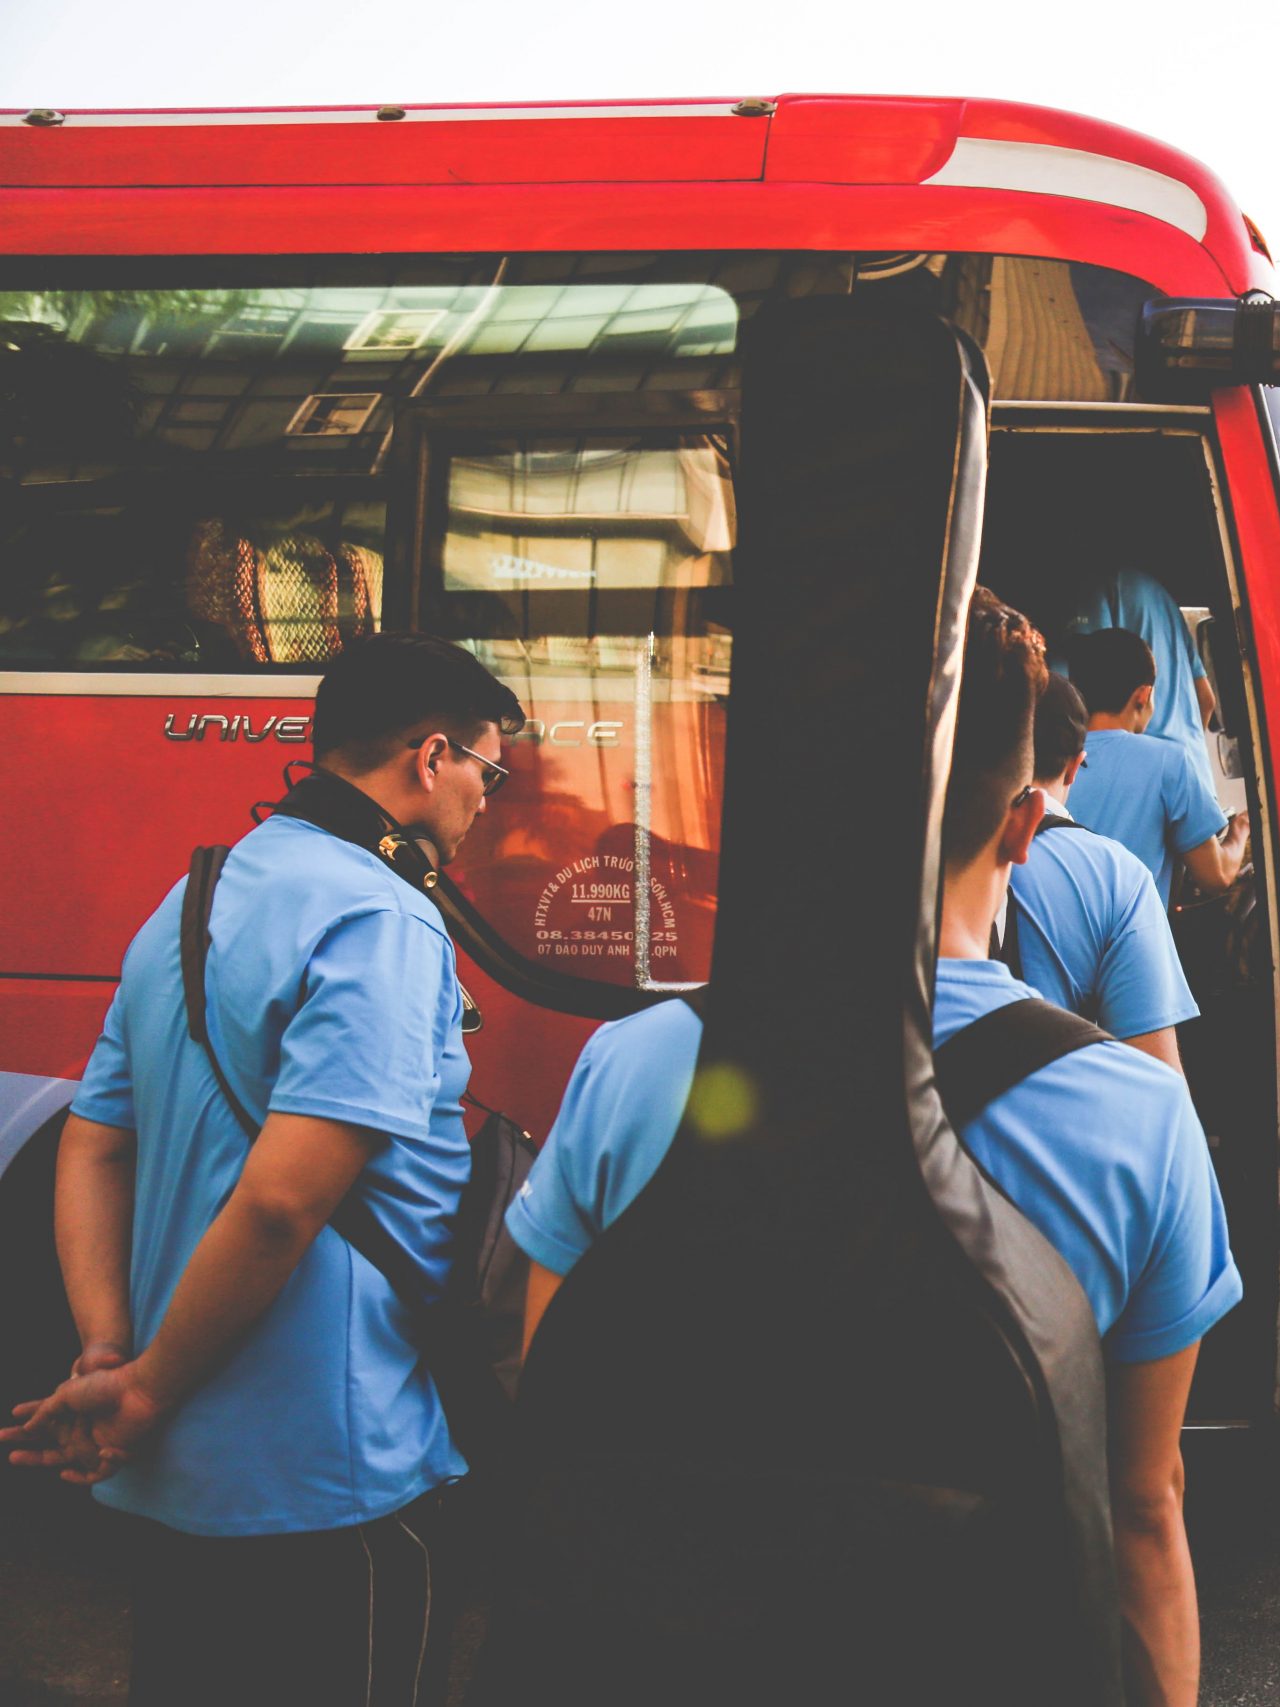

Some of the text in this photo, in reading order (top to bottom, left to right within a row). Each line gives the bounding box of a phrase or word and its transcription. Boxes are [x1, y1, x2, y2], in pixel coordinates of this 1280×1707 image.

[164, 713, 314, 743] UNIVE
[556, 867, 573, 884] DU
[573, 856, 600, 873] LỊCH
[572, 883, 631, 899] 11.990KG
[587, 906, 612, 922] 47N
[535, 930, 679, 941] 08.3845025
[537, 944, 552, 955] 07
[581, 944, 603, 955] DUY
[607, 944, 631, 956] ANH
